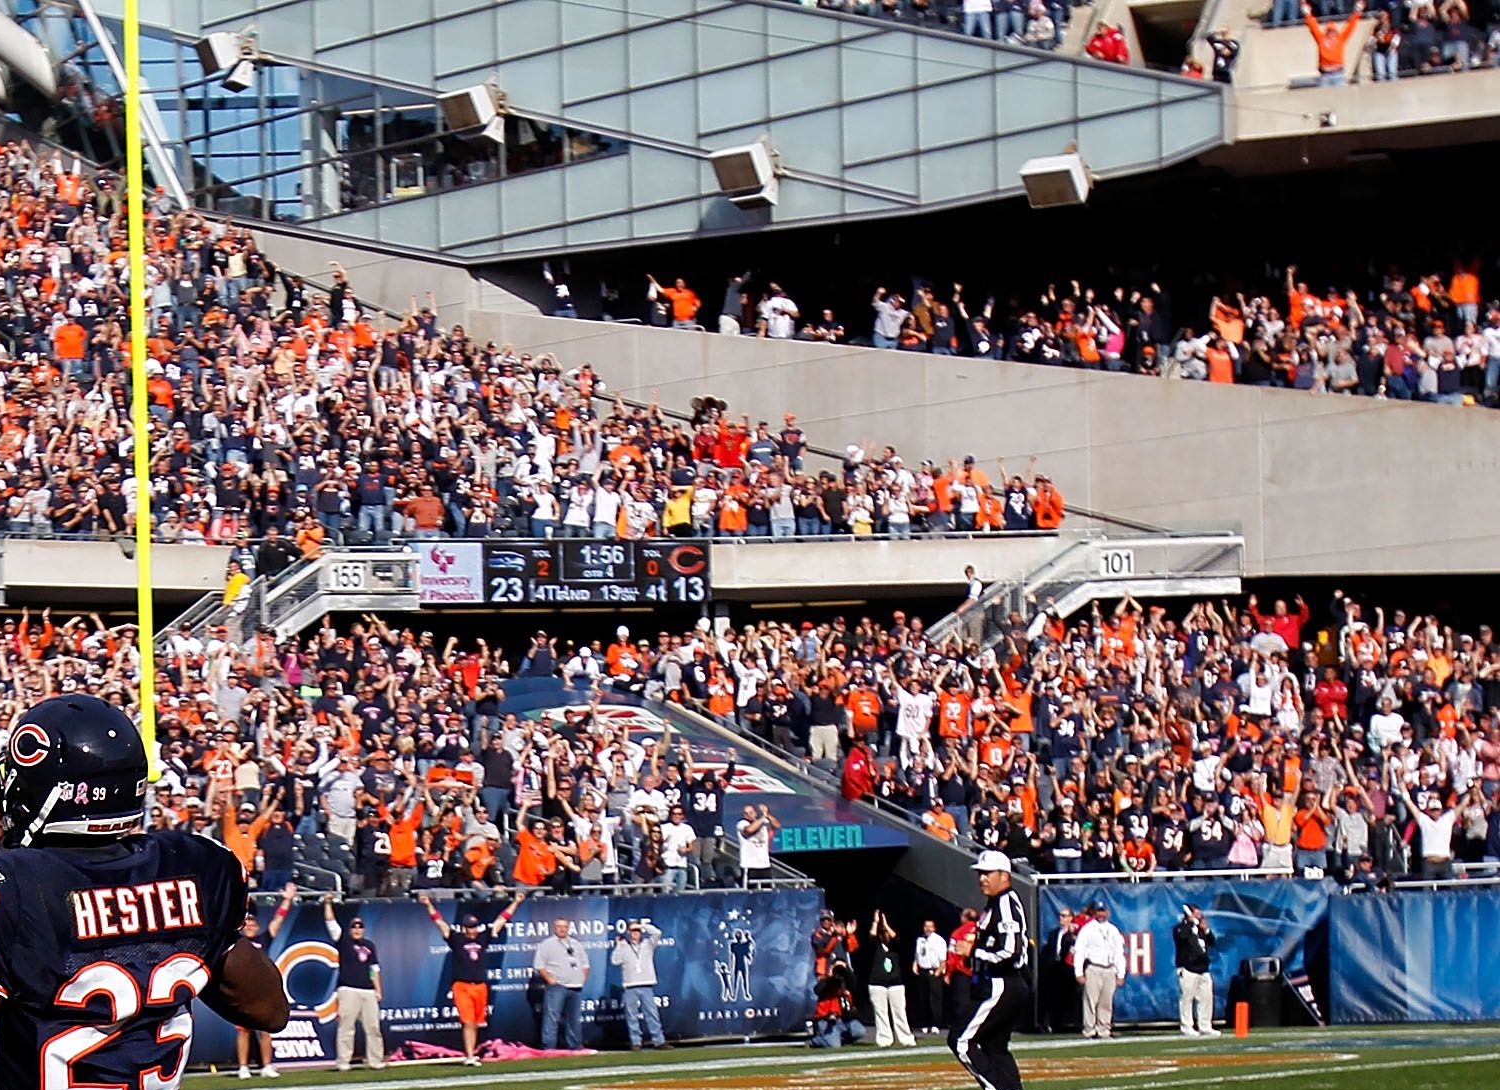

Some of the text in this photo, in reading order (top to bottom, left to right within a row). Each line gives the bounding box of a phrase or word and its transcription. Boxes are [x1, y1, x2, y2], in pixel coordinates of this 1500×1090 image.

[580, 545, 624, 564] 1:56
[1102, 553, 1132, 573] 101
[333, 565, 363, 588] 155
[537, 560, 549, 576] 2
[646, 560, 658, 576] 0
[490, 578, 524, 601] 23
[673, 577, 704, 601] 13
[92, 787, 106, 800] 99
[692, 793, 717, 813] 34
[1163, 829, 1184, 852] 54
[1201, 821, 1223, 842] 54
[72, 880, 203, 939] HESTER
[506, 921, 550, 937] TEAM
[380, 1006, 439, 1021] PEANUT'S
